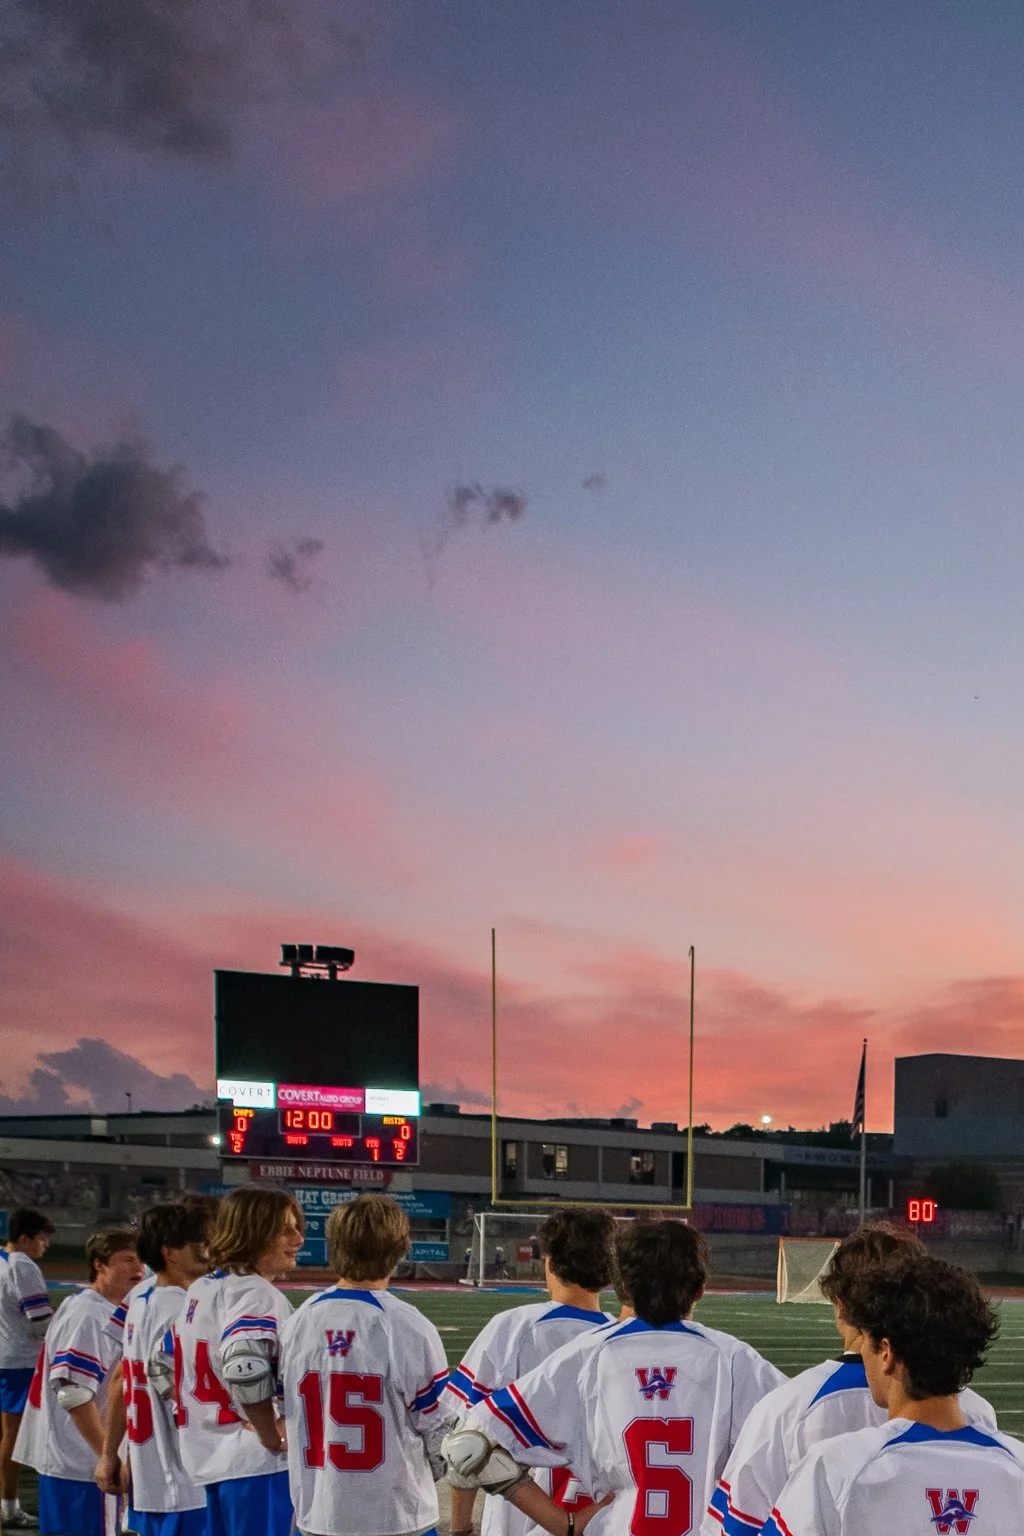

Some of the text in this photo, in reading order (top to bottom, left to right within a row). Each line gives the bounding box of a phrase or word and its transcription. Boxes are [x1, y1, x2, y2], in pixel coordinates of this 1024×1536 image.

[278, 1088, 320, 1102] COVERT
[320, 1094, 338, 1103] AUTO
[339, 1095, 363, 1105] GROUP
[237, 1116, 247, 1132] 0
[401, 1125, 411, 1140] 0
[233, 1141, 242, 1153] 2
[332, 1137, 353, 1147] SHOTS
[396, 1149, 404, 1160] 2
[259, 1165, 384, 1181] EBBIE NEPTUNE FIELD
[295, 1190, 320, 1205] HAT
[908, 1200, 933, 1222] 80
[414, 1248, 447, 1257] APITAL
[325, 1329, 357, 1358] W
[635, 1366, 678, 1401] W
[297, 1370, 386, 1473] 15
[925, 1487, 980, 1536] W
